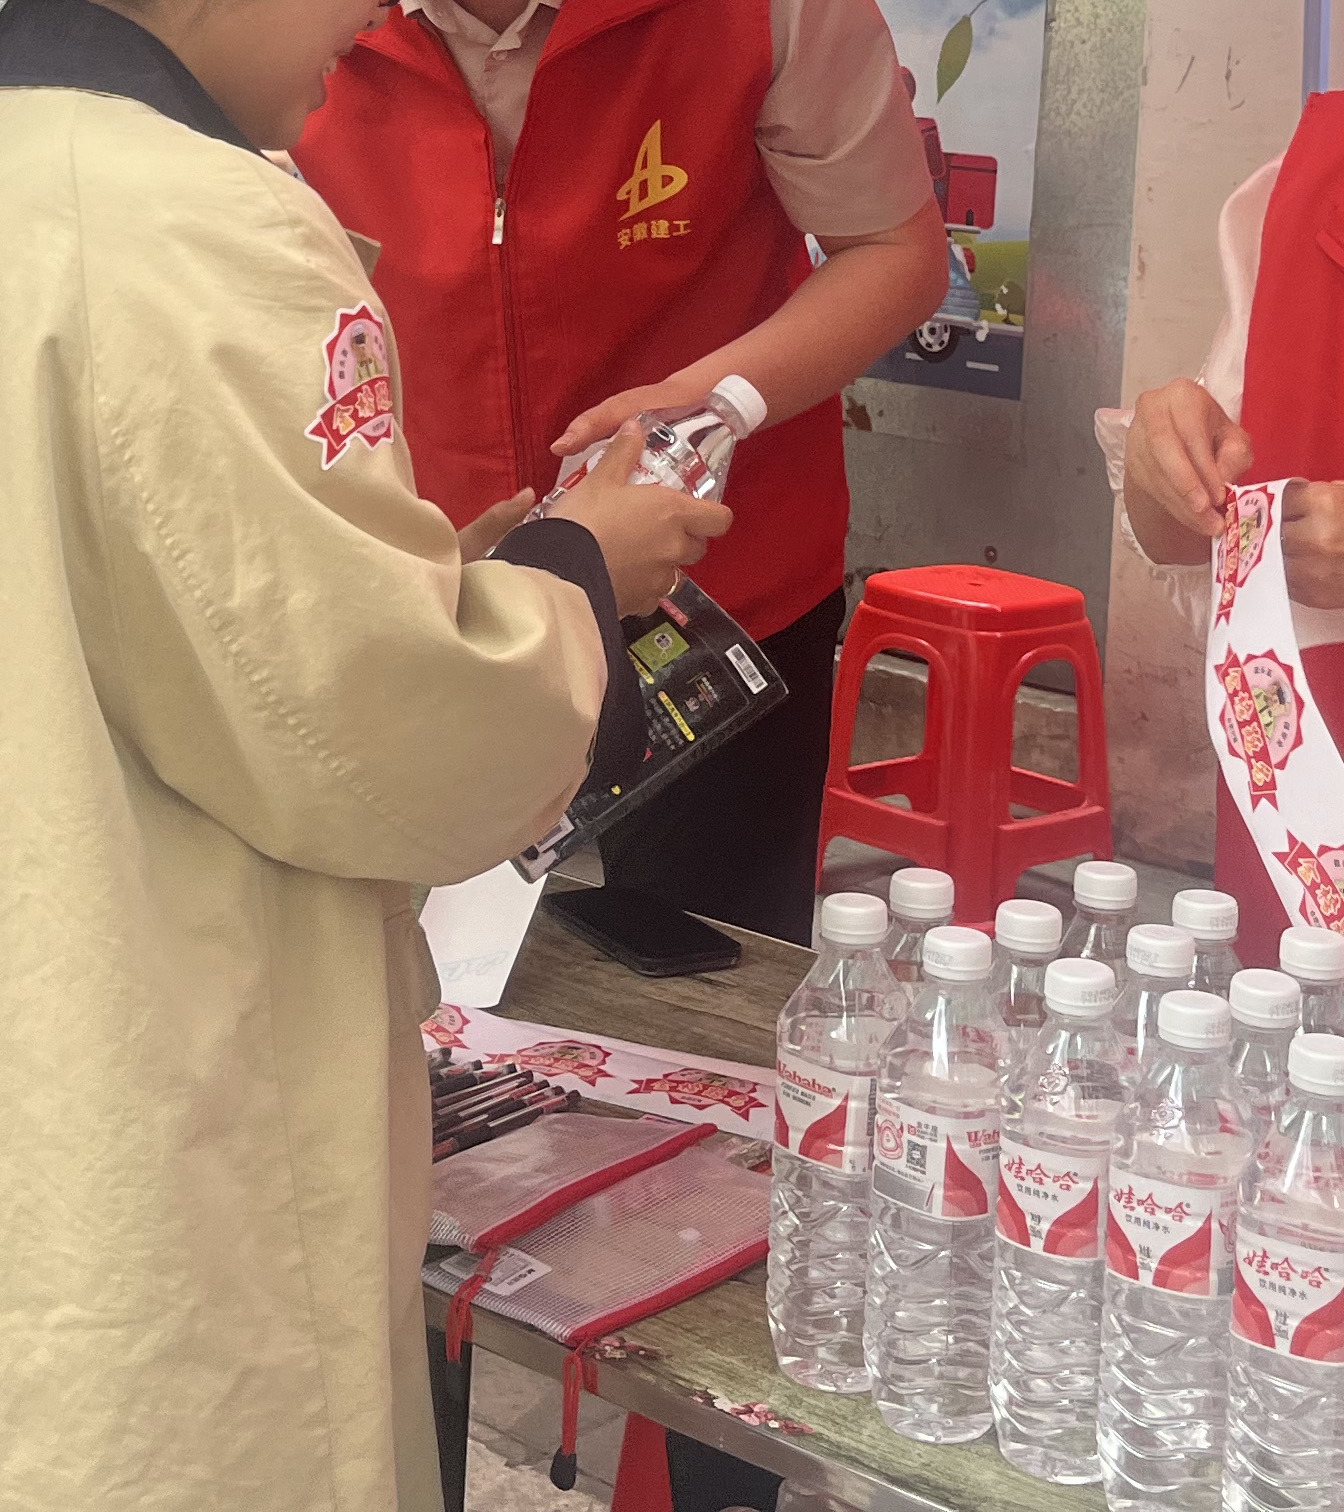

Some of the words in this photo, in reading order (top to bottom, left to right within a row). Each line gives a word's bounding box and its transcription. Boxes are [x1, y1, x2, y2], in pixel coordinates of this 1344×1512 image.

[617, 219, 692, 250] 安徽建工
[1004, 1155, 1079, 1192] 娃哈哈
[1114, 1184, 1192, 1223] 娃哈哈
[1243, 1248, 1330, 1289] 娃哈哈
